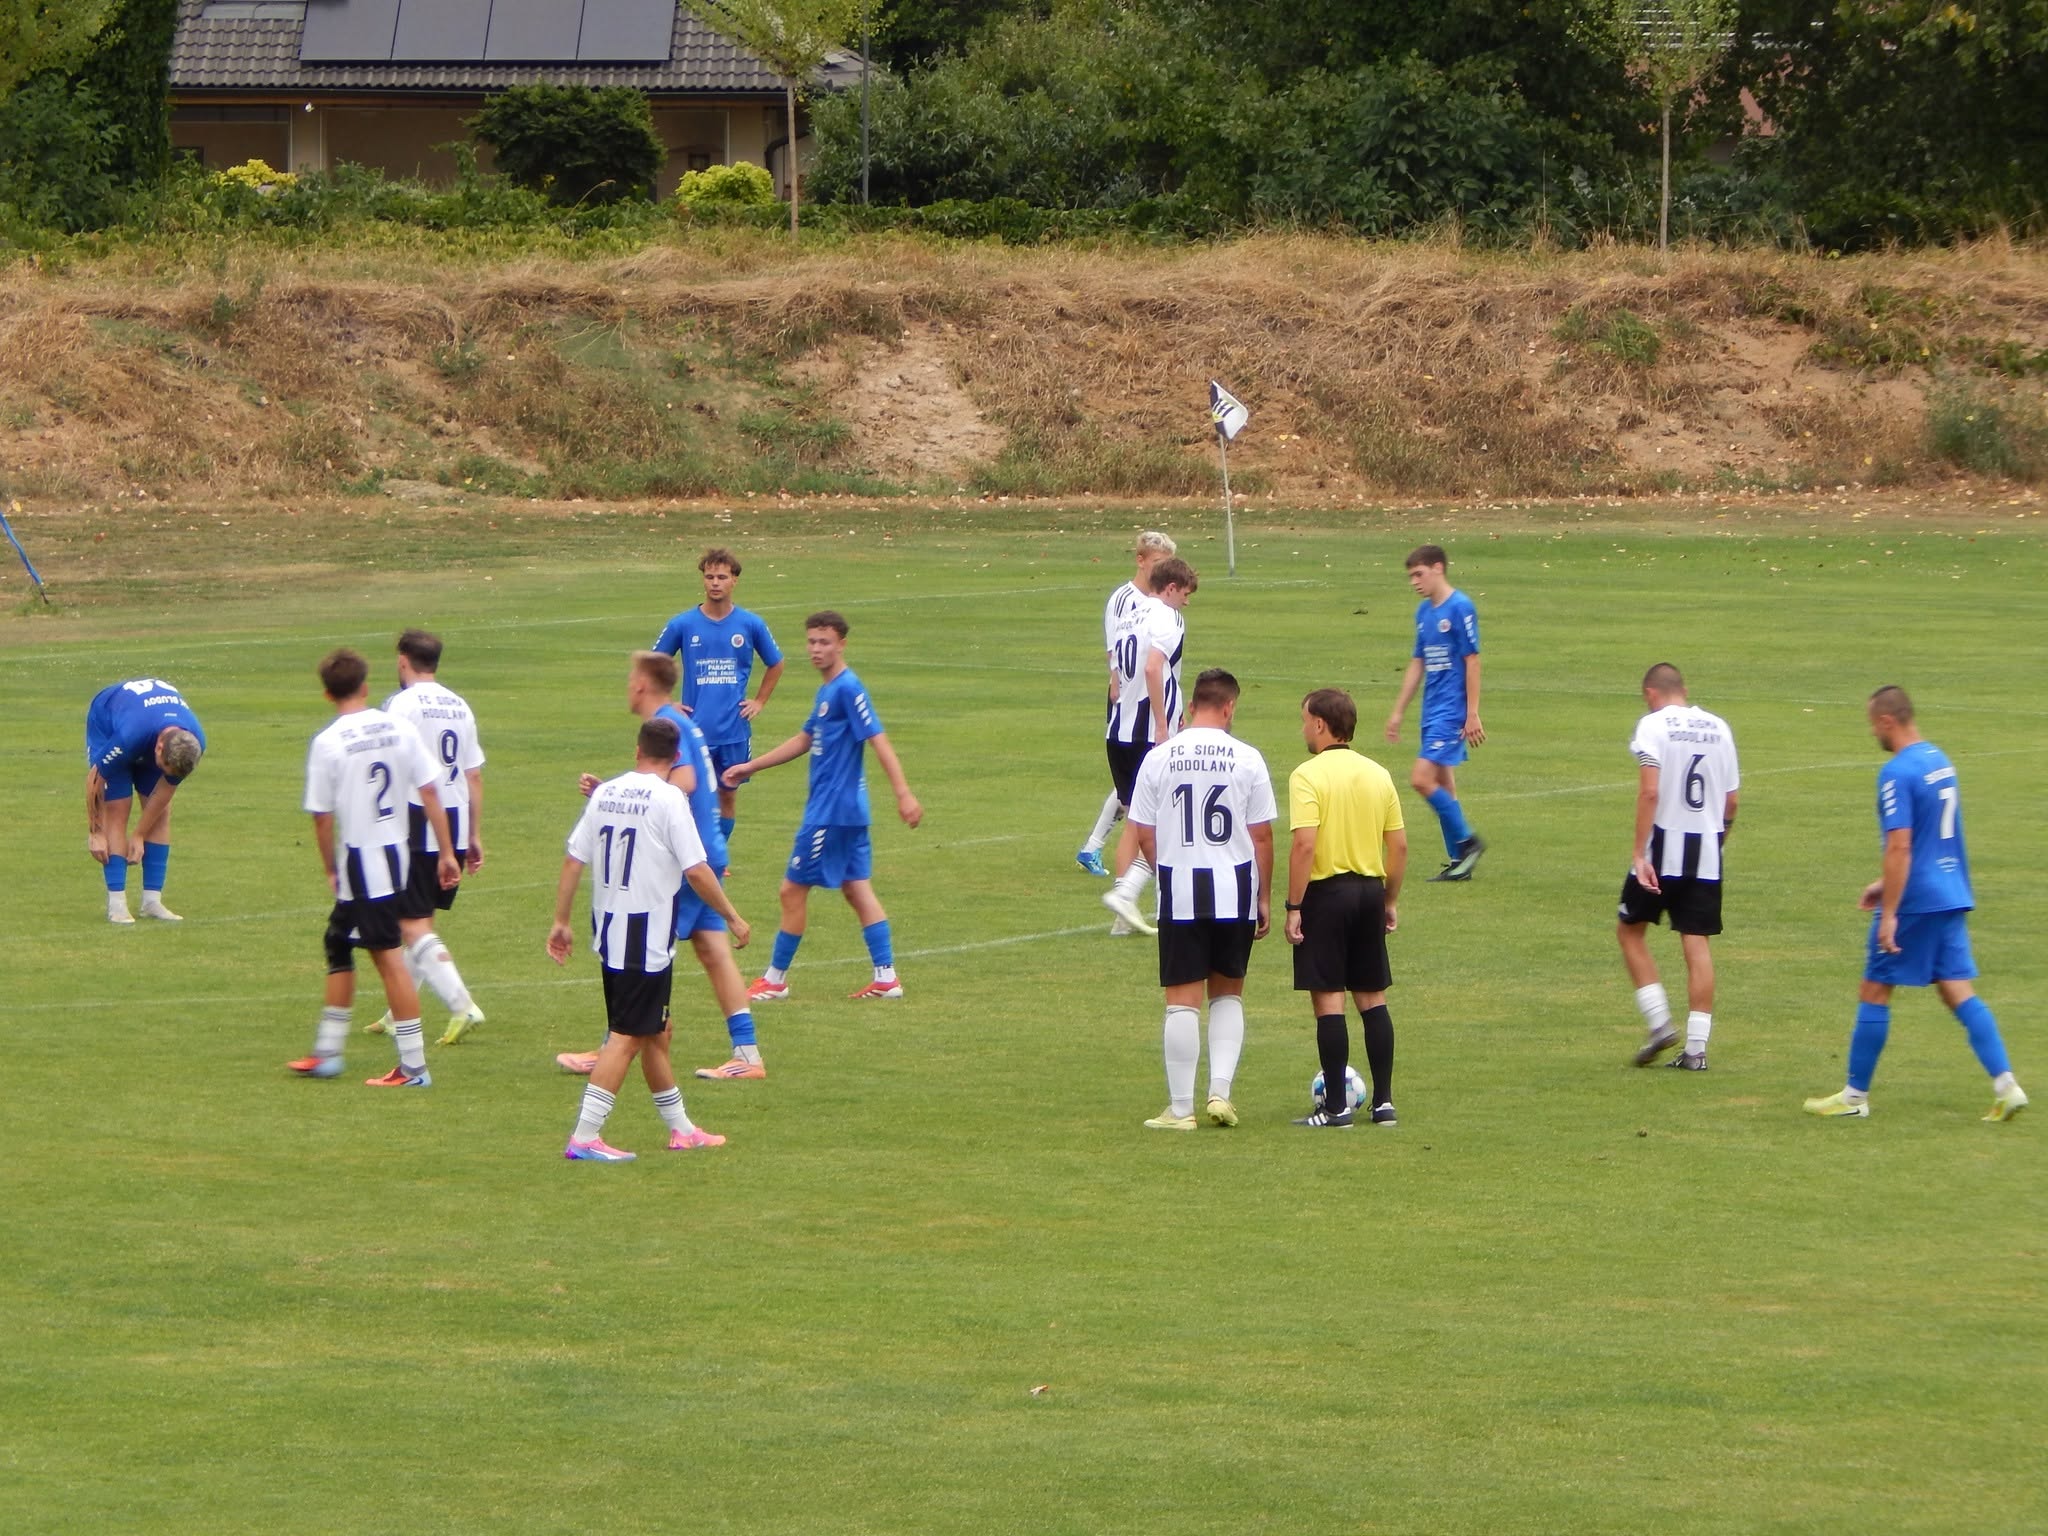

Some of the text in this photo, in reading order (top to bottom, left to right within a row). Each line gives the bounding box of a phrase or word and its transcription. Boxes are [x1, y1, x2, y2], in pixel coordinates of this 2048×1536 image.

[1115, 633, 1138, 683] 10
[143, 695, 179, 708] BLUDOV
[438, 729, 459, 787] 9
[1169, 759, 1236, 774] HODOLANY
[1170, 744, 1234, 759] FC SIGMA
[366, 760, 397, 823] 2
[598, 800, 649, 817] HODOLANY
[621, 787, 652, 800] SIGMA
[1682, 753, 1706, 813] 6
[1171, 783, 1233, 848] 16
[1938, 786, 1957, 840] 7
[598, 824, 637, 891] 11
